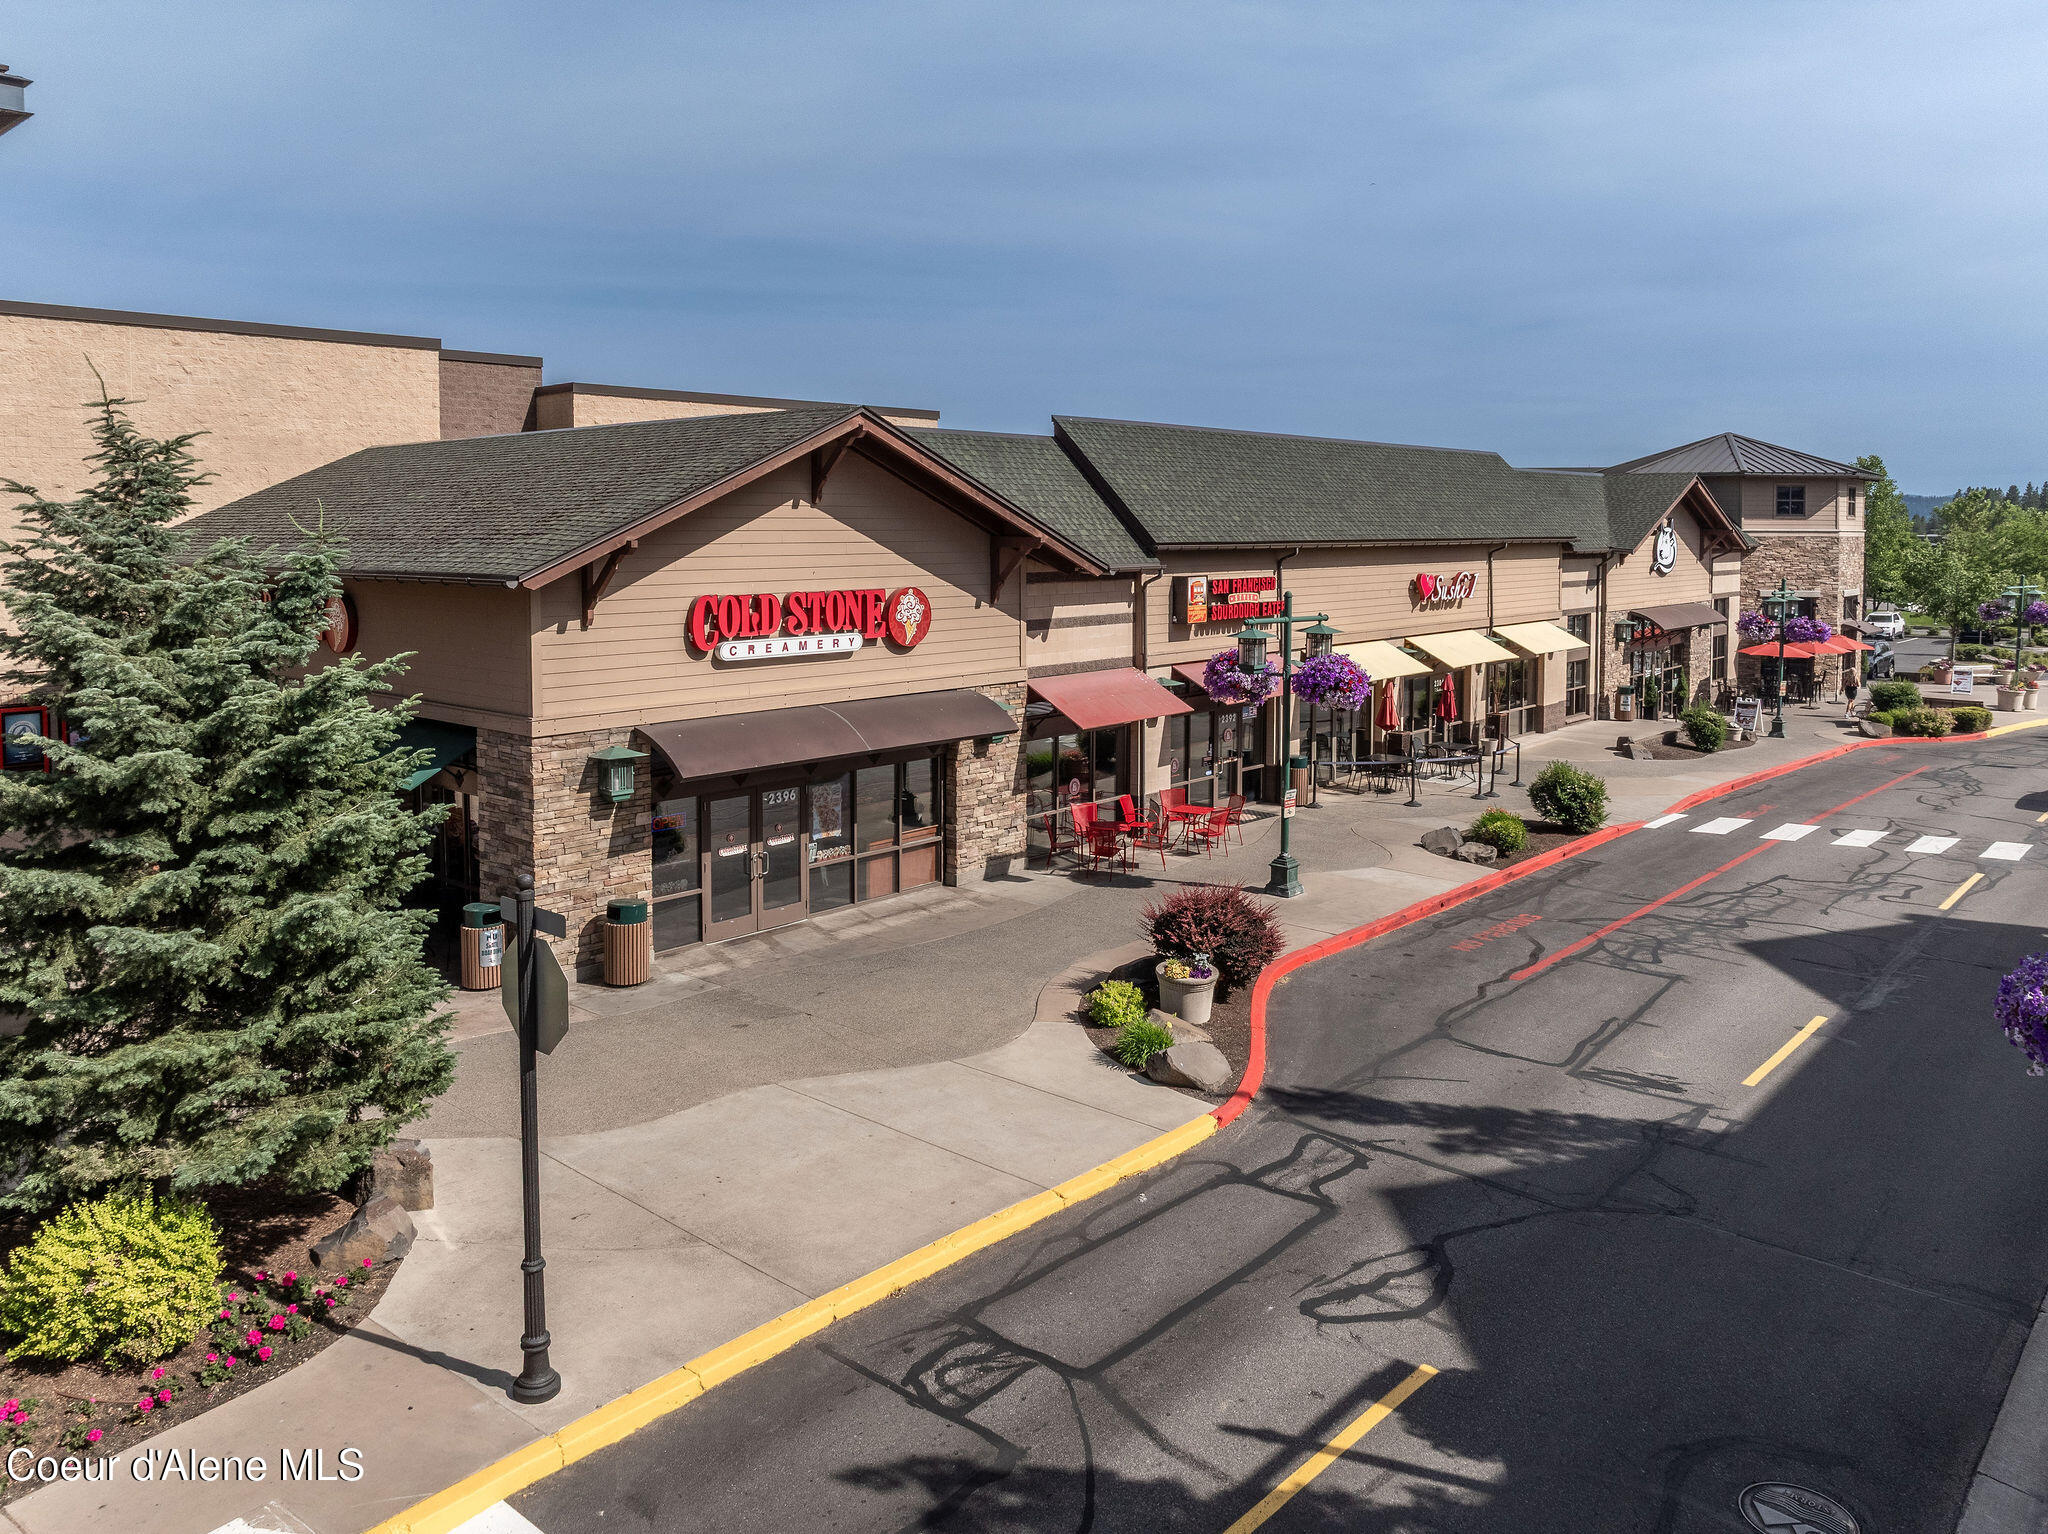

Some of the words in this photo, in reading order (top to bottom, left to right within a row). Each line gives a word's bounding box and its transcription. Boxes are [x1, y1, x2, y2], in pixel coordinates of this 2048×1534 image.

[1212, 579, 1229, 595] SAN
[1232, 577, 1277, 593] FRANCISCO
[1431, 571, 1472, 601] Sushi
[1211, 602, 1260, 621] SOURDOUGH
[1262, 600, 1286, 616] EATER
[692, 593, 782, 652] COLD
[785, 588, 887, 639] STONE
[729, 637, 855, 656] CREAMERY
[1221, 713, 1236, 723] 2392
[768, 789, 796, 805] 2396
[652, 815, 684, 830] OPEN
